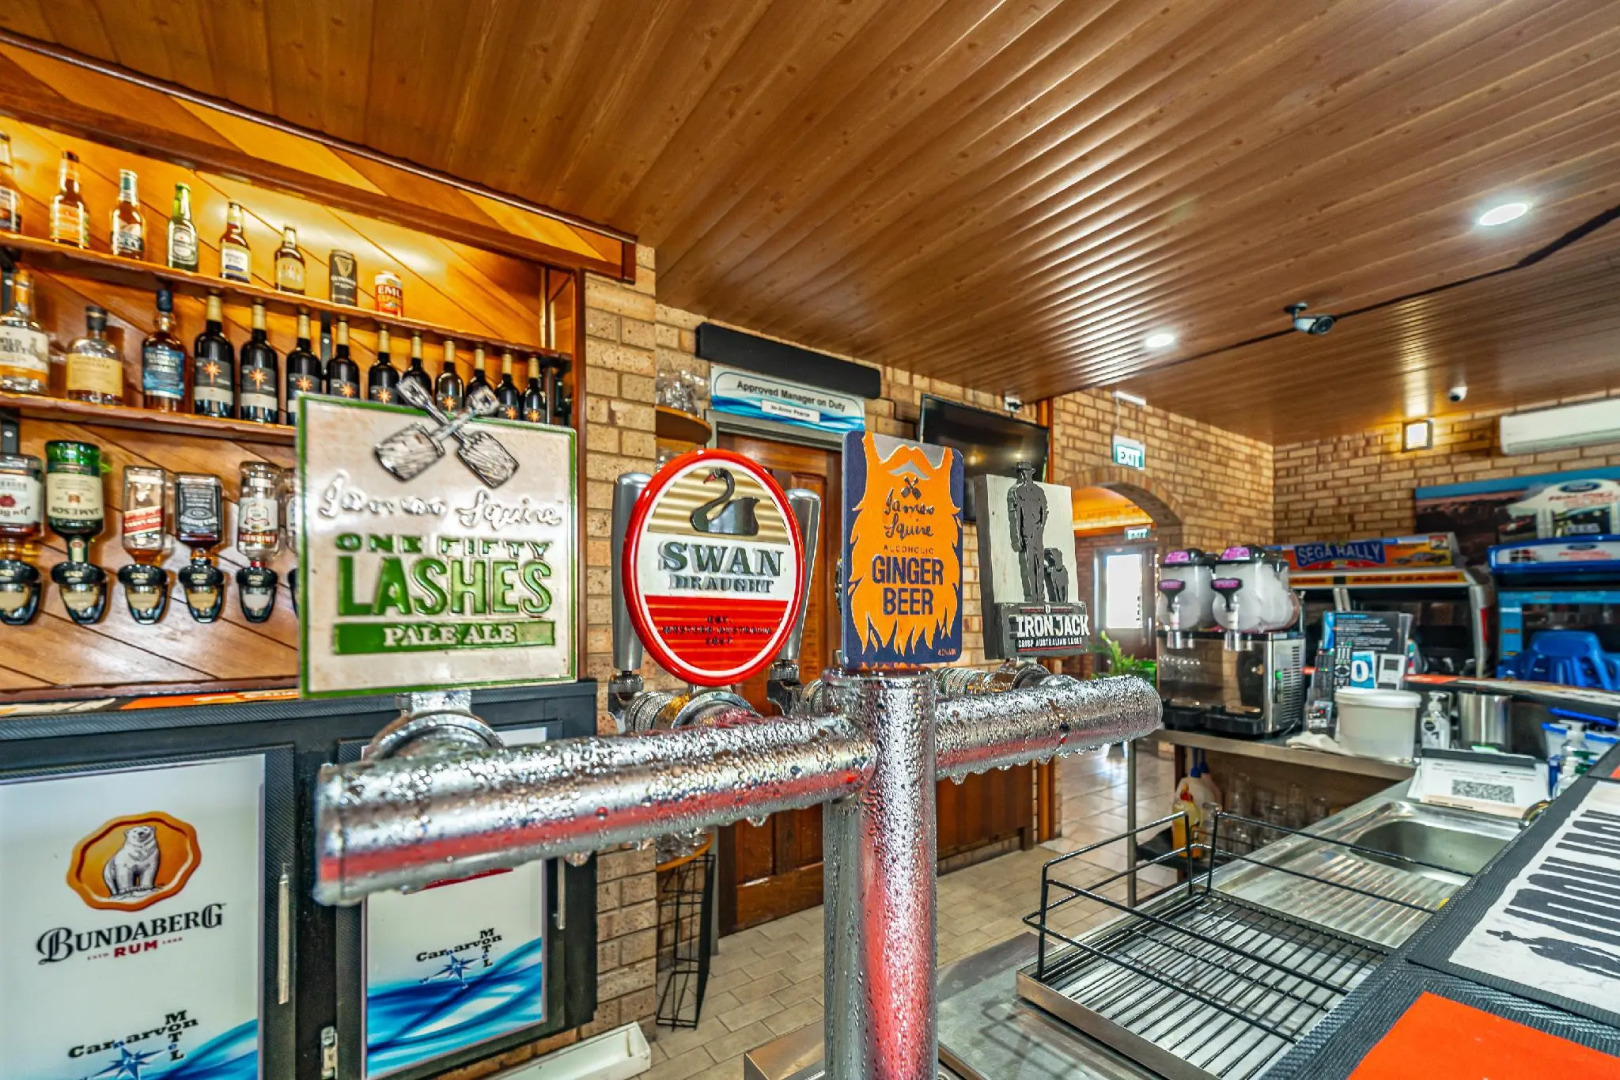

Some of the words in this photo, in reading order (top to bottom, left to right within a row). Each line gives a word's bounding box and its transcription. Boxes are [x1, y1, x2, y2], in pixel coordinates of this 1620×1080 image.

[737, 381, 779, 397] Approved
[781, 390, 815, 405] Manager
[817, 398, 827, 406] on
[829, 399, 846, 412] Duty
[1116, 446, 1143, 468] EXIT
[51, 506, 99, 515] JAMESON
[457, 490, 562, 530] Squire
[884, 487, 935, 516] James
[884, 514, 934, 541] Squire
[1127, 529, 1149, 540] EXIT
[335, 533, 424, 555] ONE
[437, 536, 554, 559] FIFTY
[659, 541, 785, 577] SWAN
[883, 545, 934, 555] ALCOHOLIC
[1299, 544, 1334, 565] SEGA
[1338, 541, 1382, 564] RALLY
[872, 555, 944, 586] GINGER
[337, 556, 554, 617] LASHES
[669, 574, 774, 594] DRAUGHT
[882, 588, 934, 616] BEER
[384, 626, 460, 648] PALE
[464, 624, 518, 645] ALE
[1016, 615, 1054, 637] IRON
[1053, 614, 1090, 636] JACK
[36, 902, 226, 965] BUNDABERG
[113, 940, 159, 958] RUM
